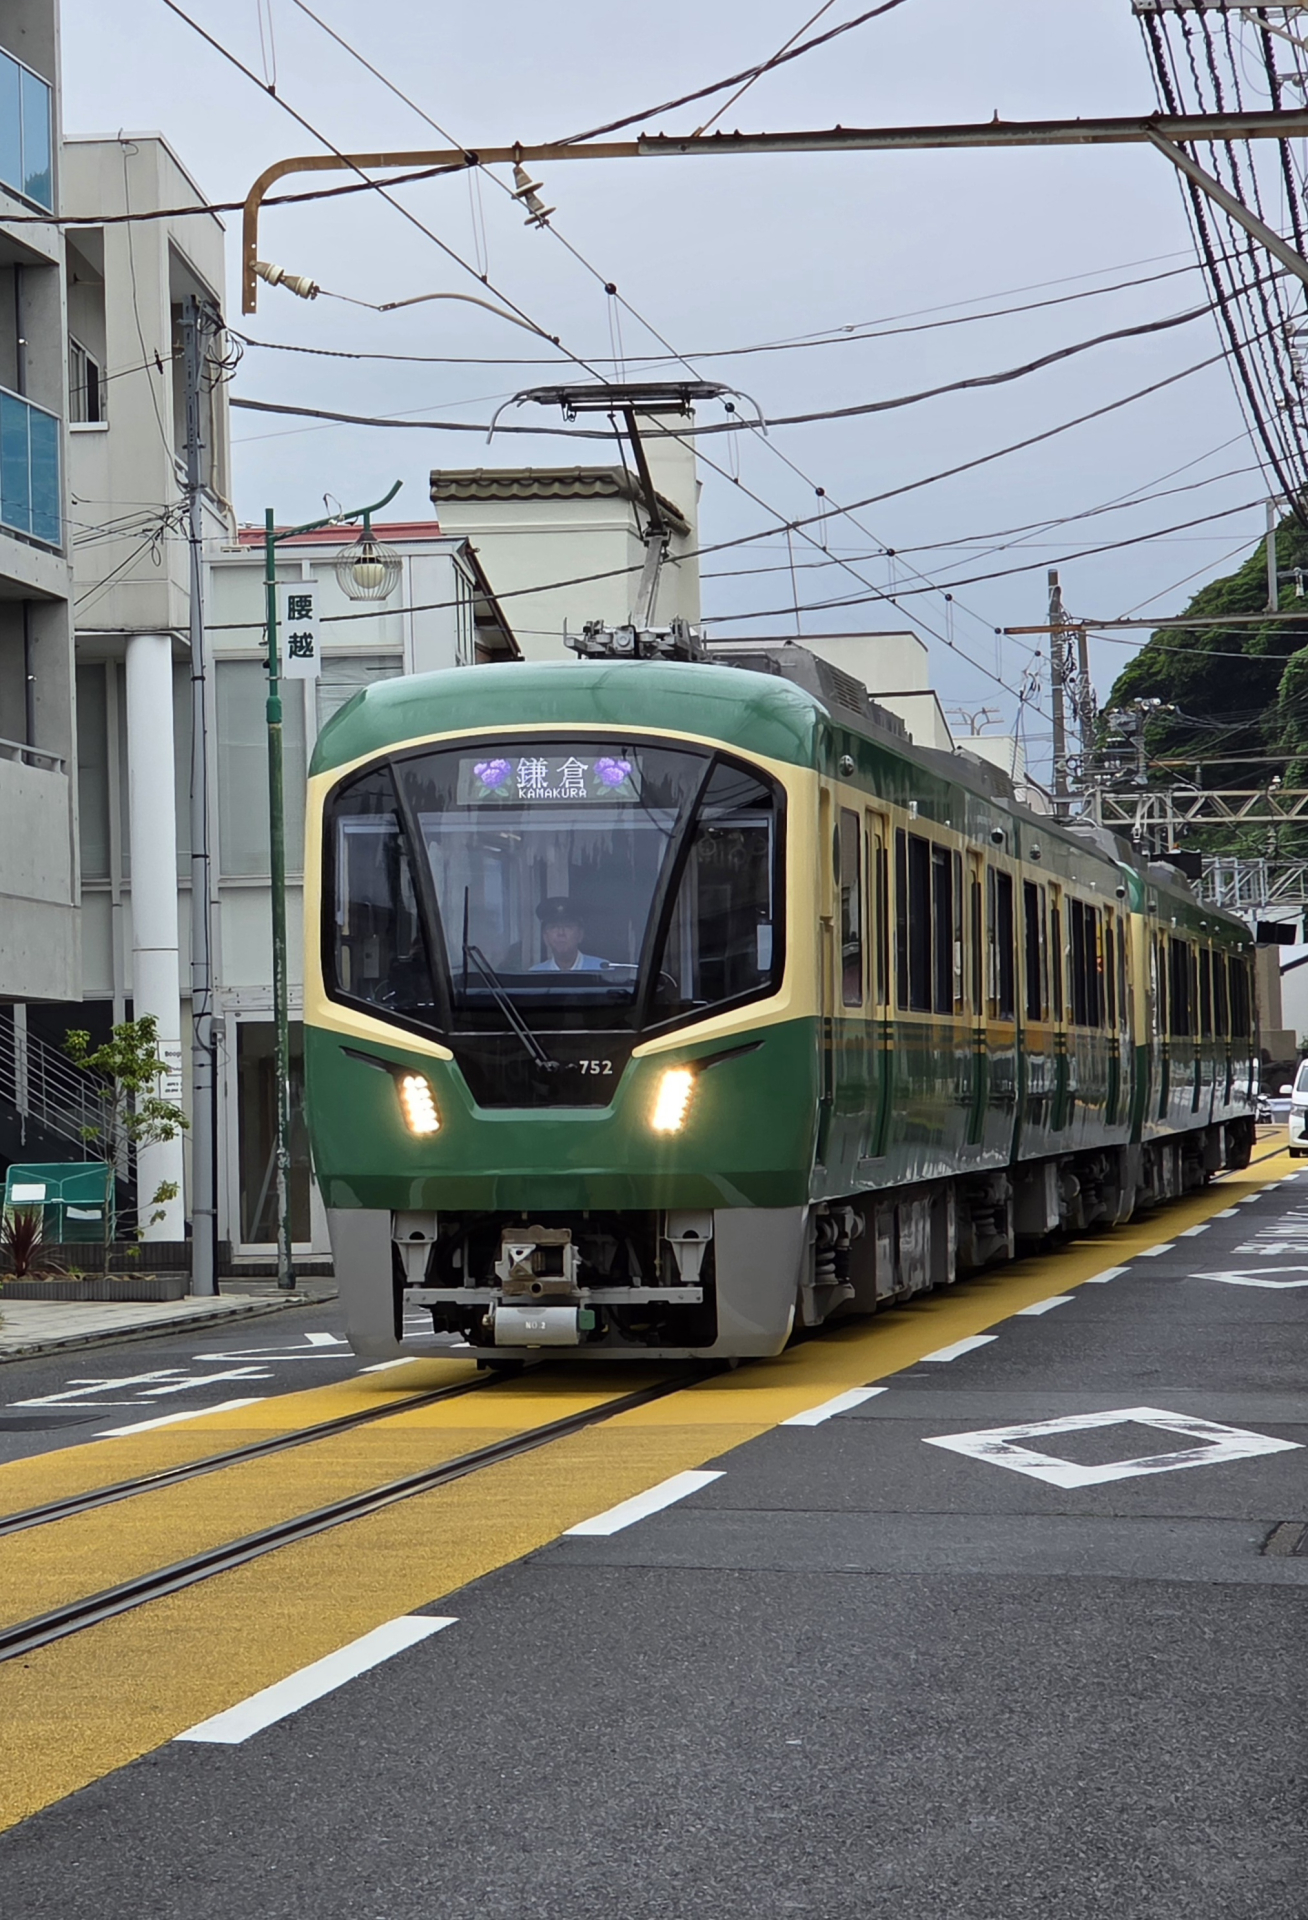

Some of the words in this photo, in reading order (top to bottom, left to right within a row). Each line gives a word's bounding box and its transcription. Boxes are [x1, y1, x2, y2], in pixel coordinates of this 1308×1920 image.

[288, 594, 314, 659] 腰越
[516, 756, 589, 789] 鎌倉
[518, 788, 587, 799] KAMAKURA
[579, 1060, 613, 1075] 752
